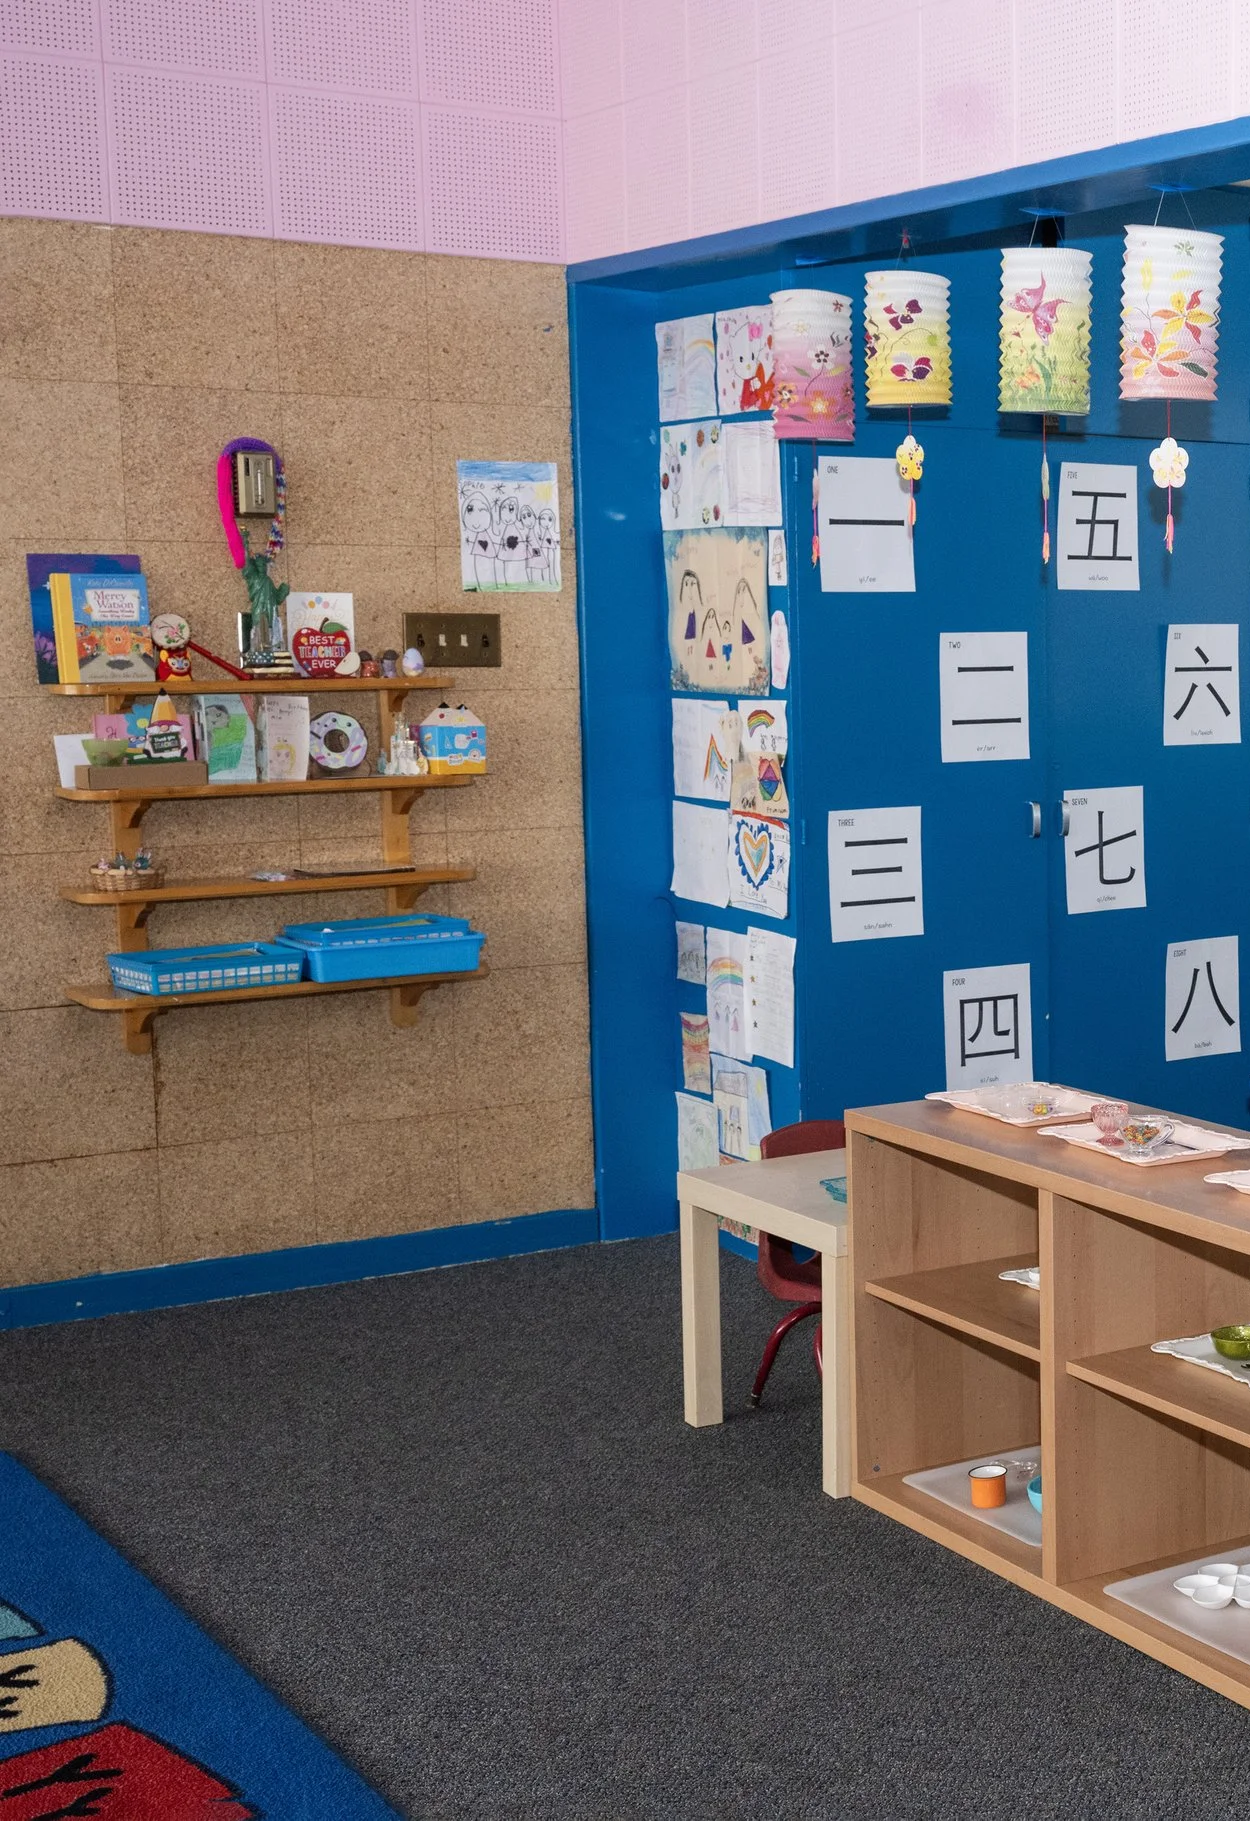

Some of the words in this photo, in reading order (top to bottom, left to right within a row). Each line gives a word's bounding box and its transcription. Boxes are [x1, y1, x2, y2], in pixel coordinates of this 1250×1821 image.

[826, 465, 839, 474] ONE
[1066, 470, 1079, 480] FIVE
[828, 518, 905, 527] 一
[1067, 490, 1133, 562] 五
[93, 590, 127, 600] Mercy
[97, 600, 134, 609] Watson
[309, 635, 335, 645] BEST
[948, 640, 962, 649] TWO
[298, 645, 346, 659] TEACHER
[311, 659, 337, 669] EVER
[1173, 645, 1232, 721] 六
[951, 666, 1022, 726] 二
[1071, 797, 1089, 807] SEVEN
[837, 818, 855, 828] THREE
[1074, 811, 1137, 886] 七
[840, 837, 916, 908] 三
[1173, 948, 1187, 958] EIGHT
[951, 977, 966, 987] FOUR
[1171, 961, 1236, 1034] 八
[959, 993, 1020, 1067] 四
